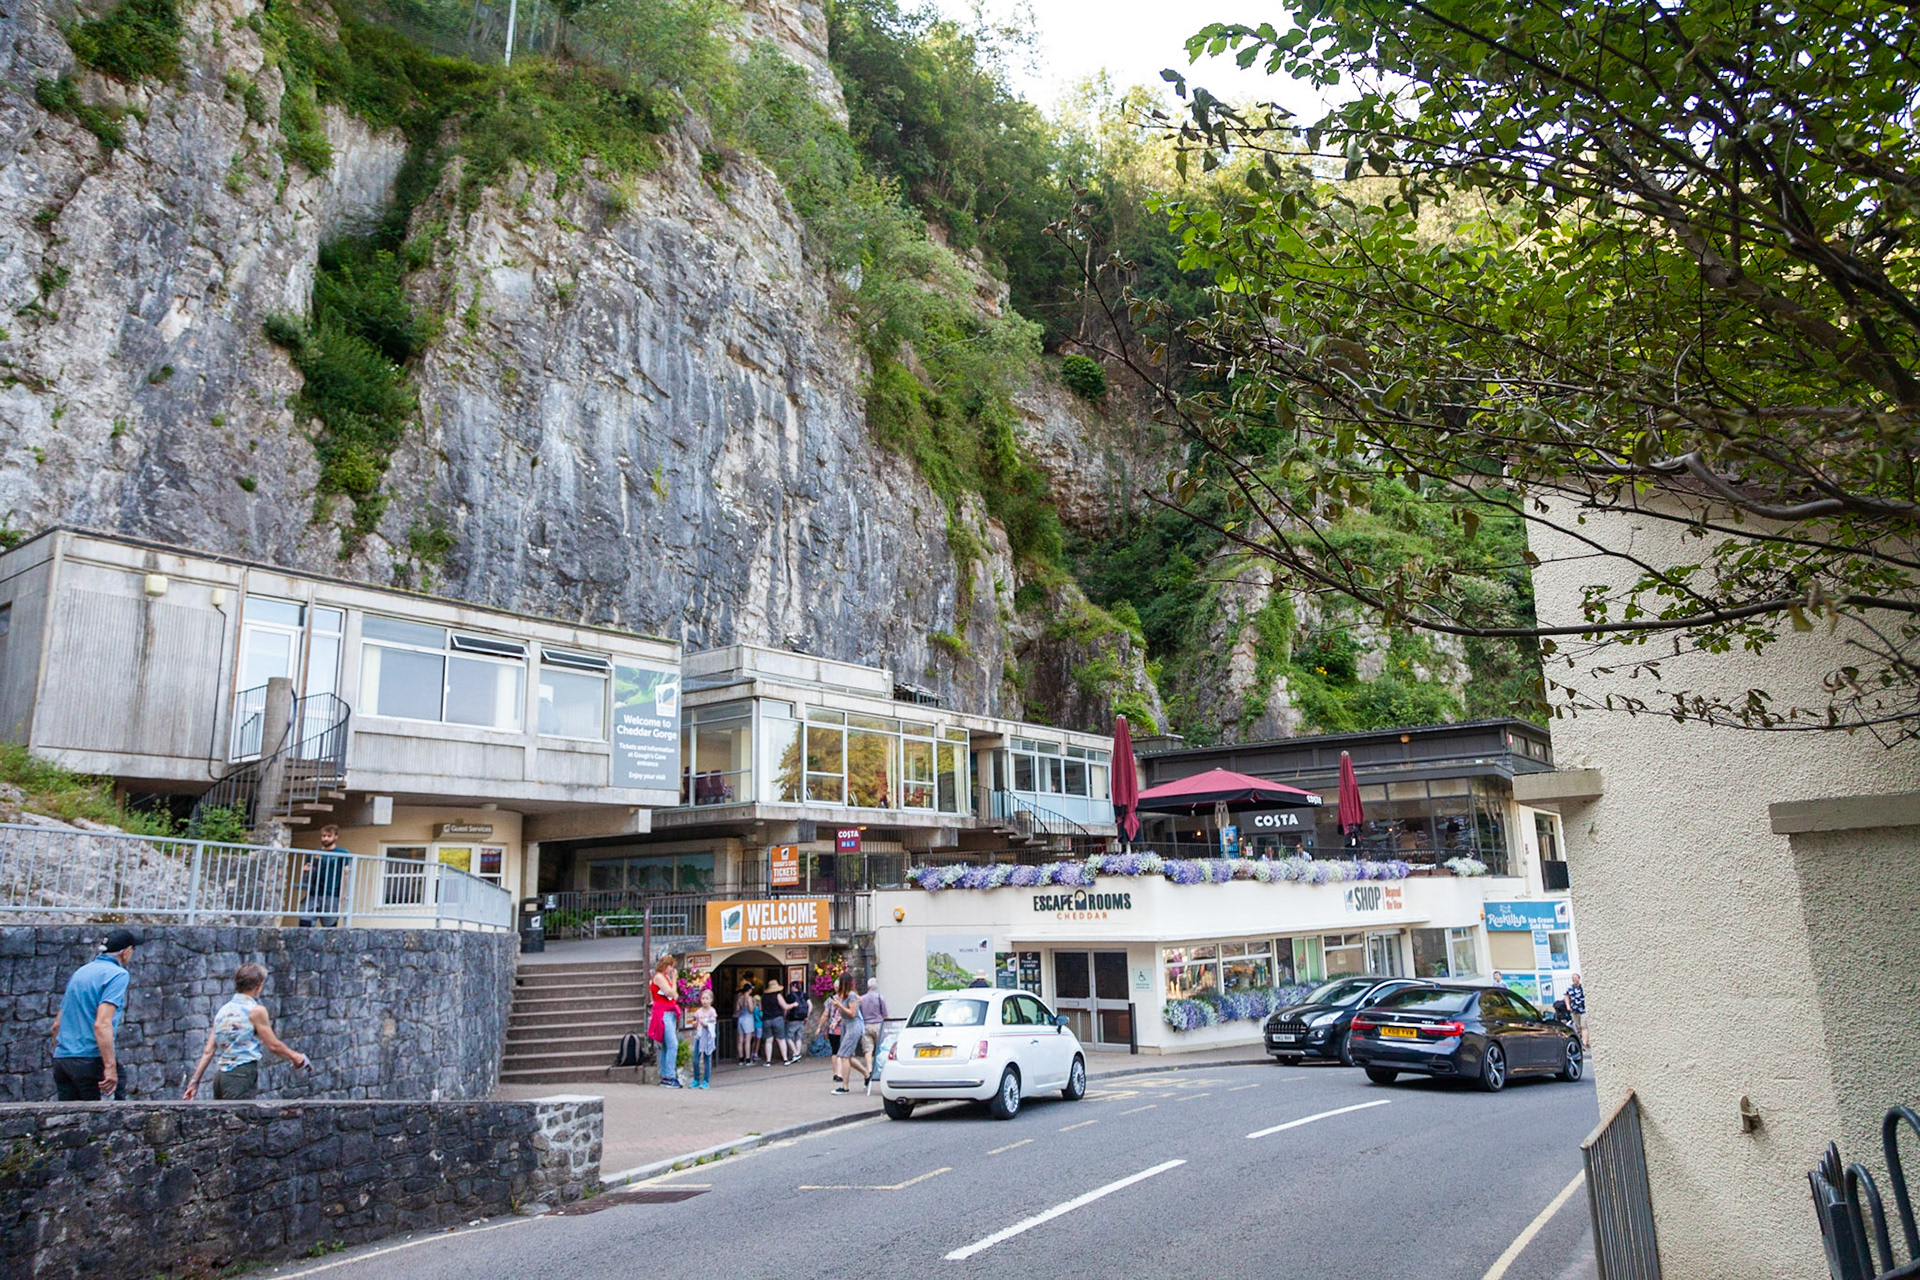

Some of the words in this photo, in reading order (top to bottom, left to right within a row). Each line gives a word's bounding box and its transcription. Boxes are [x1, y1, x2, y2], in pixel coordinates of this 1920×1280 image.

[623, 714, 661, 727] Welcome
[662, 719, 671, 728] to
[616, 725, 651, 737] Cheddar
[652, 729, 677, 741] Gorge
[619, 742, 637, 750] Tickets
[634, 752, 654, 760] Gough's
[628, 772, 643, 780] Enjoy
[1306, 795, 1322, 804] COSTA
[1254, 813, 1299, 827] COSTA
[838, 830, 859, 838] COSTA
[773, 867, 797, 877] TICKETS
[1033, 894, 1074, 911] ESCAPE
[1088, 893, 1132, 910] ROOMS
[1354, 886, 1381, 912] SHOP
[746, 902, 818, 926] WELCOME
[1056, 912, 1108, 920] CHEDDAR
[747, 928, 758, 942] TO
[760, 926, 797, 940] GOUGH'S
[798, 925, 818, 939] CAVE
